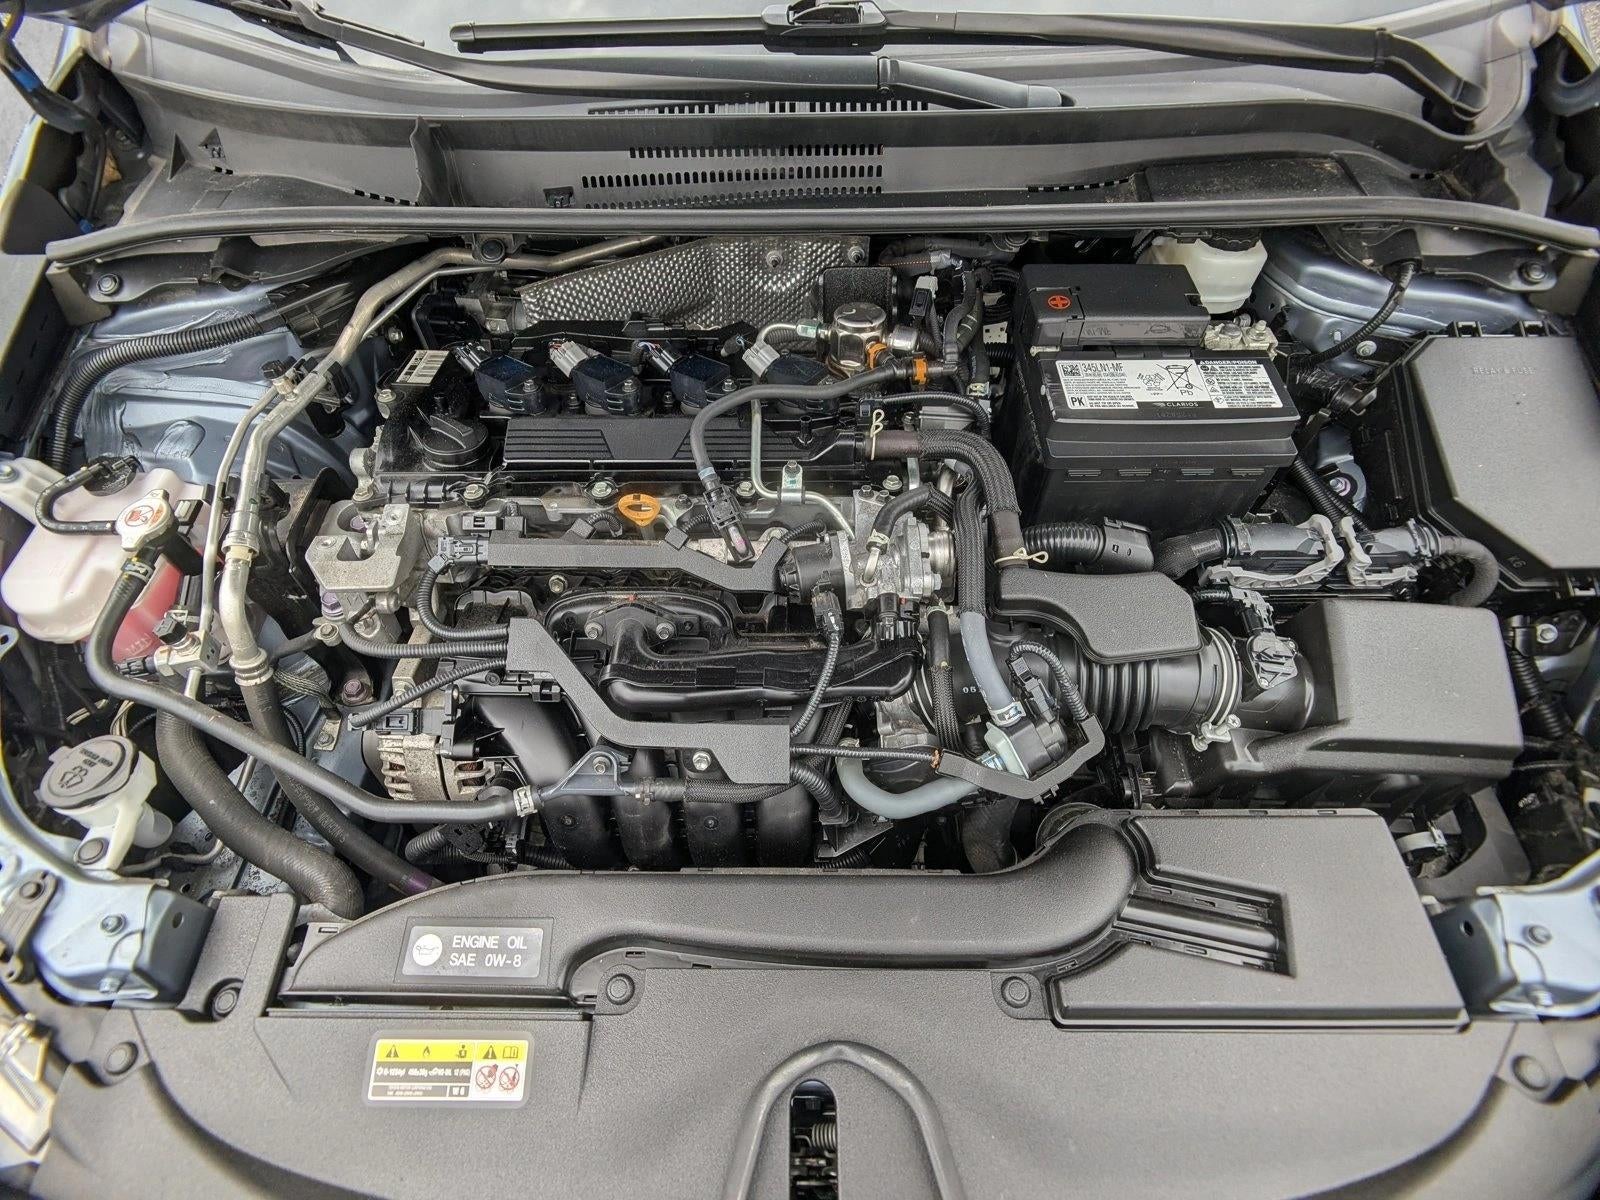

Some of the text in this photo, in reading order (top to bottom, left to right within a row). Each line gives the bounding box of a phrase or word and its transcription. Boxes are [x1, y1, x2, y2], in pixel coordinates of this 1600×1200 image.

[1082, 363, 1124, 372] 345LN1-MF
[1070, 397, 1085, 406] PK
[452, 935, 528, 950] ENGINE OIL
[449, 953, 522, 968] SAE 0W-8
